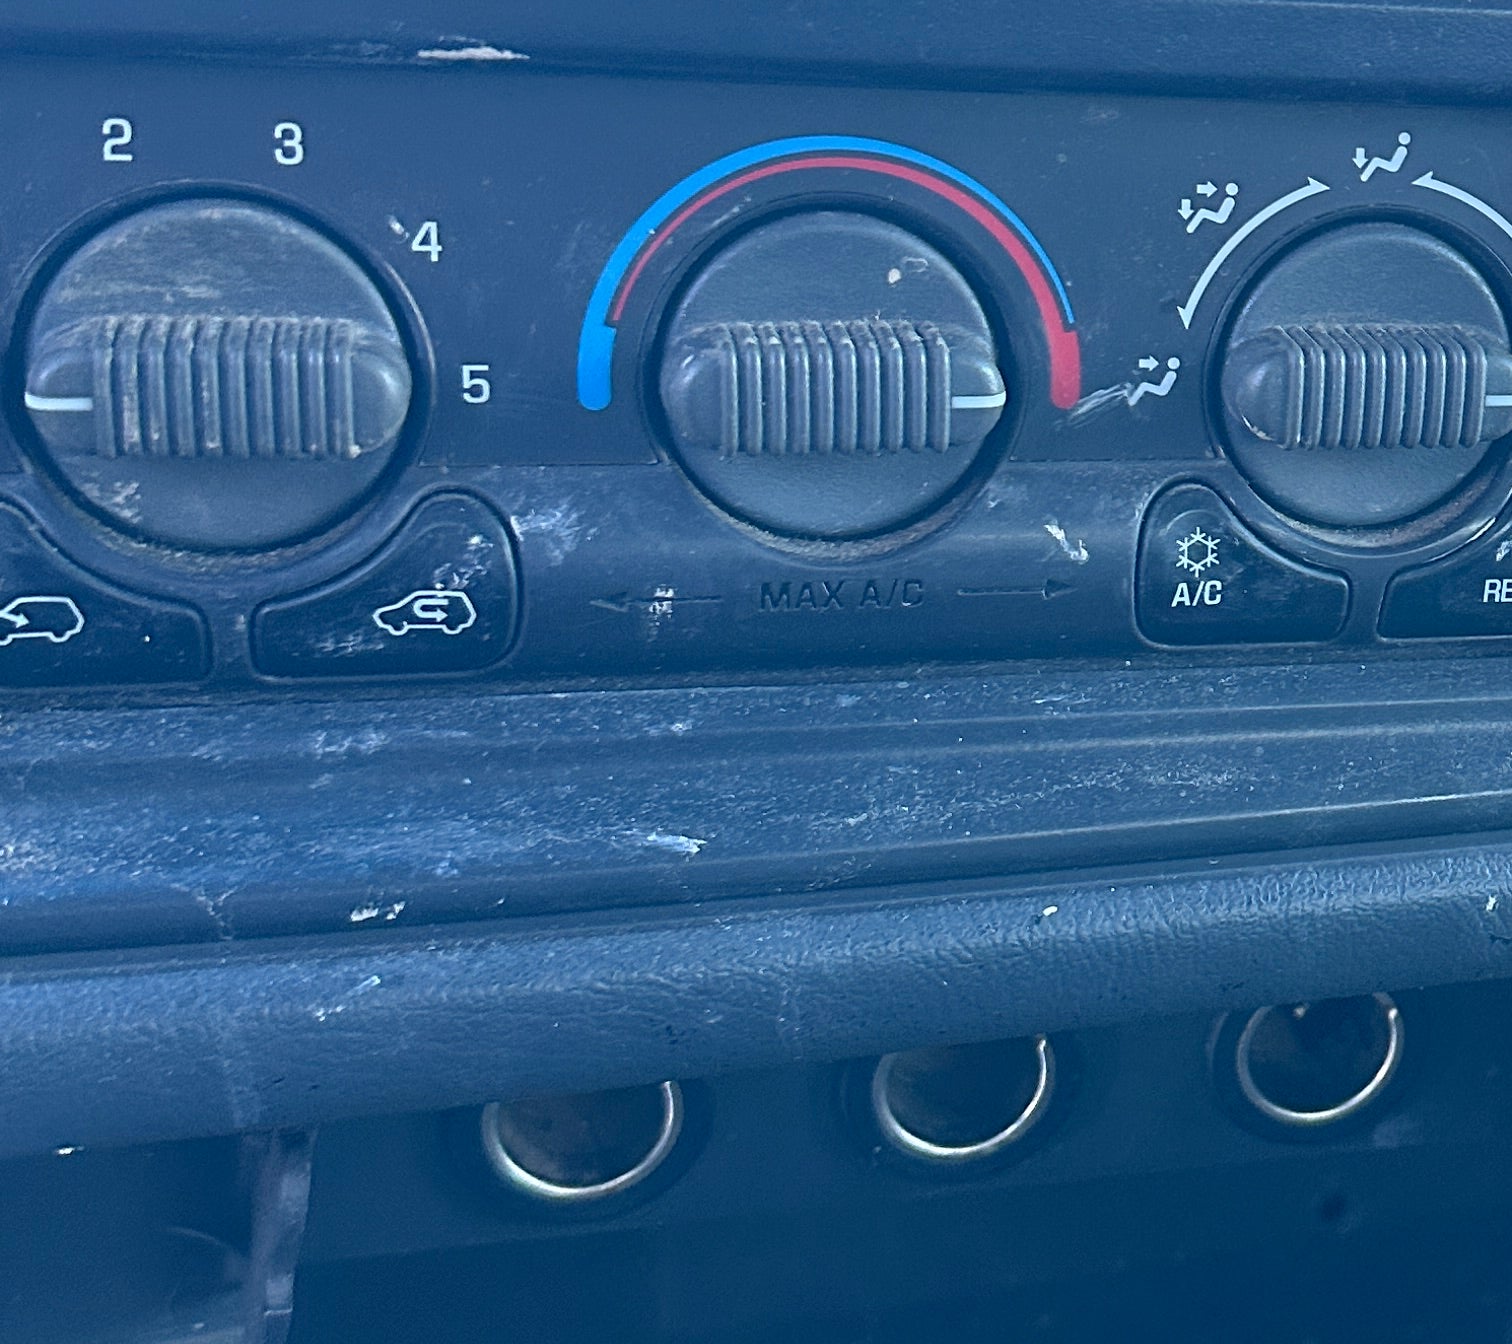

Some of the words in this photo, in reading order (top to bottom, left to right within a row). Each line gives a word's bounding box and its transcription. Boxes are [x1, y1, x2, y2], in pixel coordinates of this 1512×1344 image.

[102, 118, 133, 162] 2
[273, 122, 303, 165] 3
[411, 221, 442, 261] 4
[462, 365, 489, 403] 5
[760, 581, 845, 612] MAX
[859, 579, 925, 608] A/C
[1171, 581, 1223, 608] A/C
